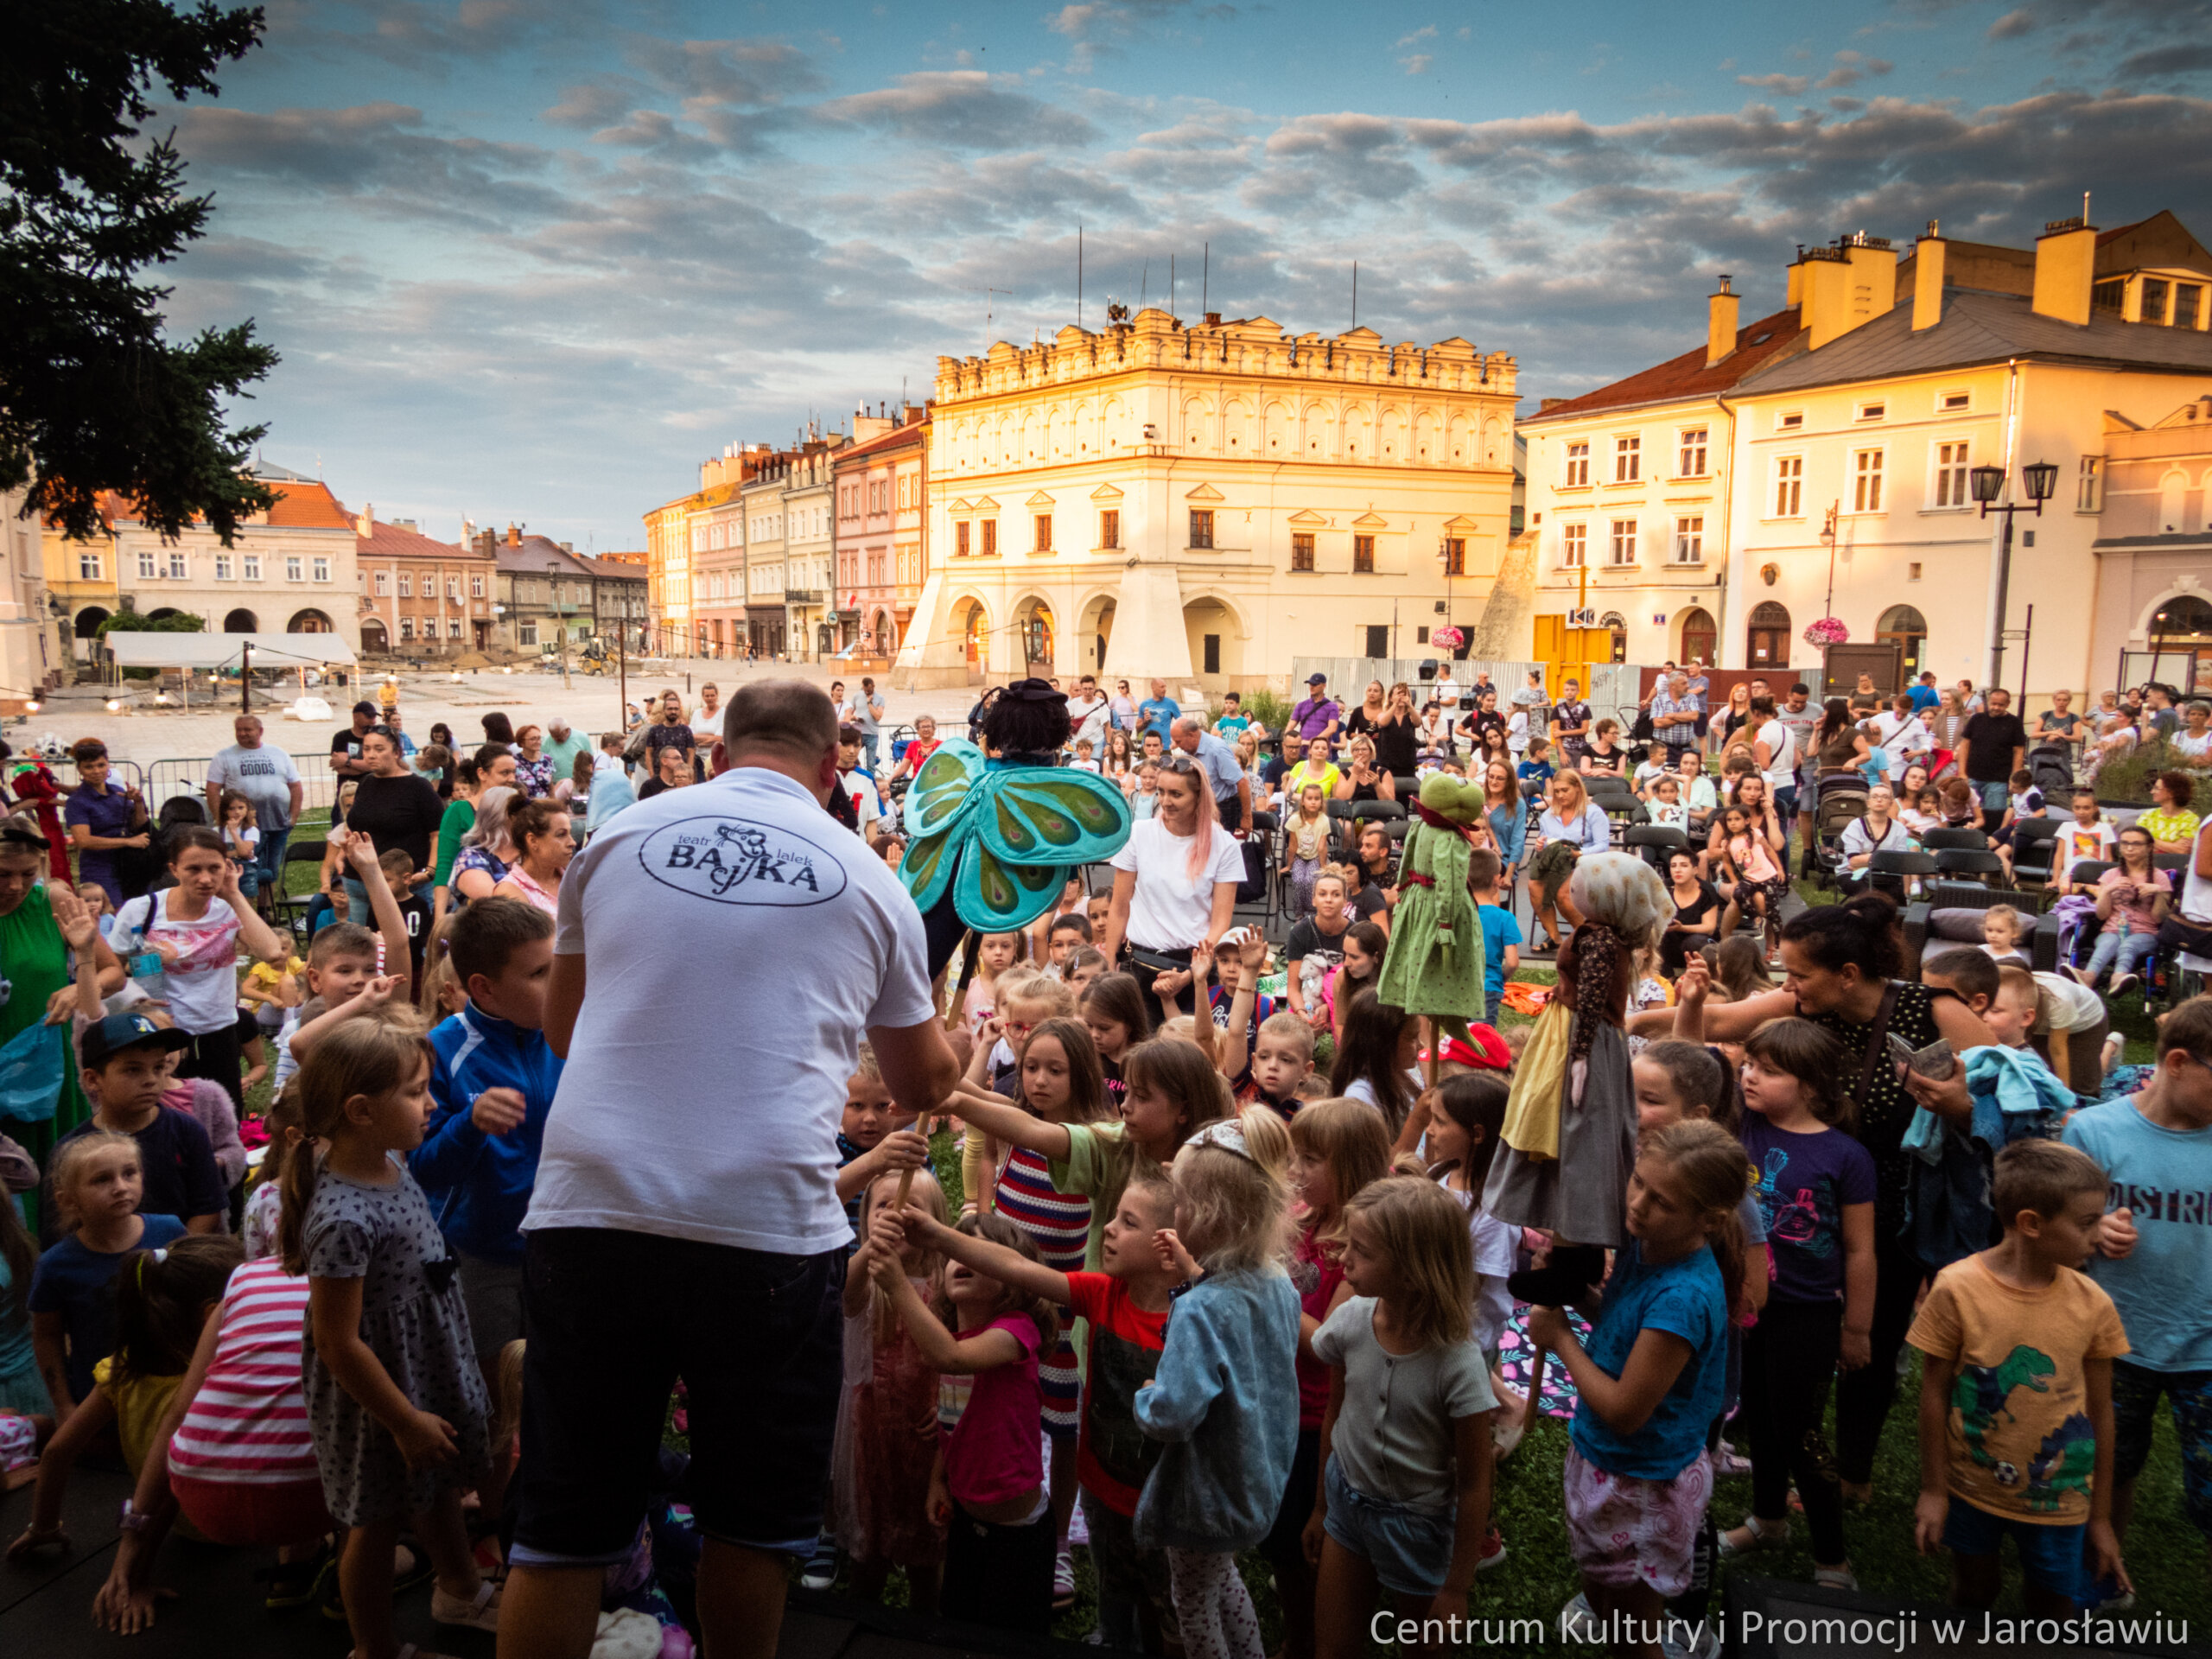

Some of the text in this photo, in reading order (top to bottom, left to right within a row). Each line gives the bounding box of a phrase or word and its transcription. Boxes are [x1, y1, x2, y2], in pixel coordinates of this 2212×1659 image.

[240, 763, 275, 776] GOODS
[678, 834, 813, 867] teatr lalek
